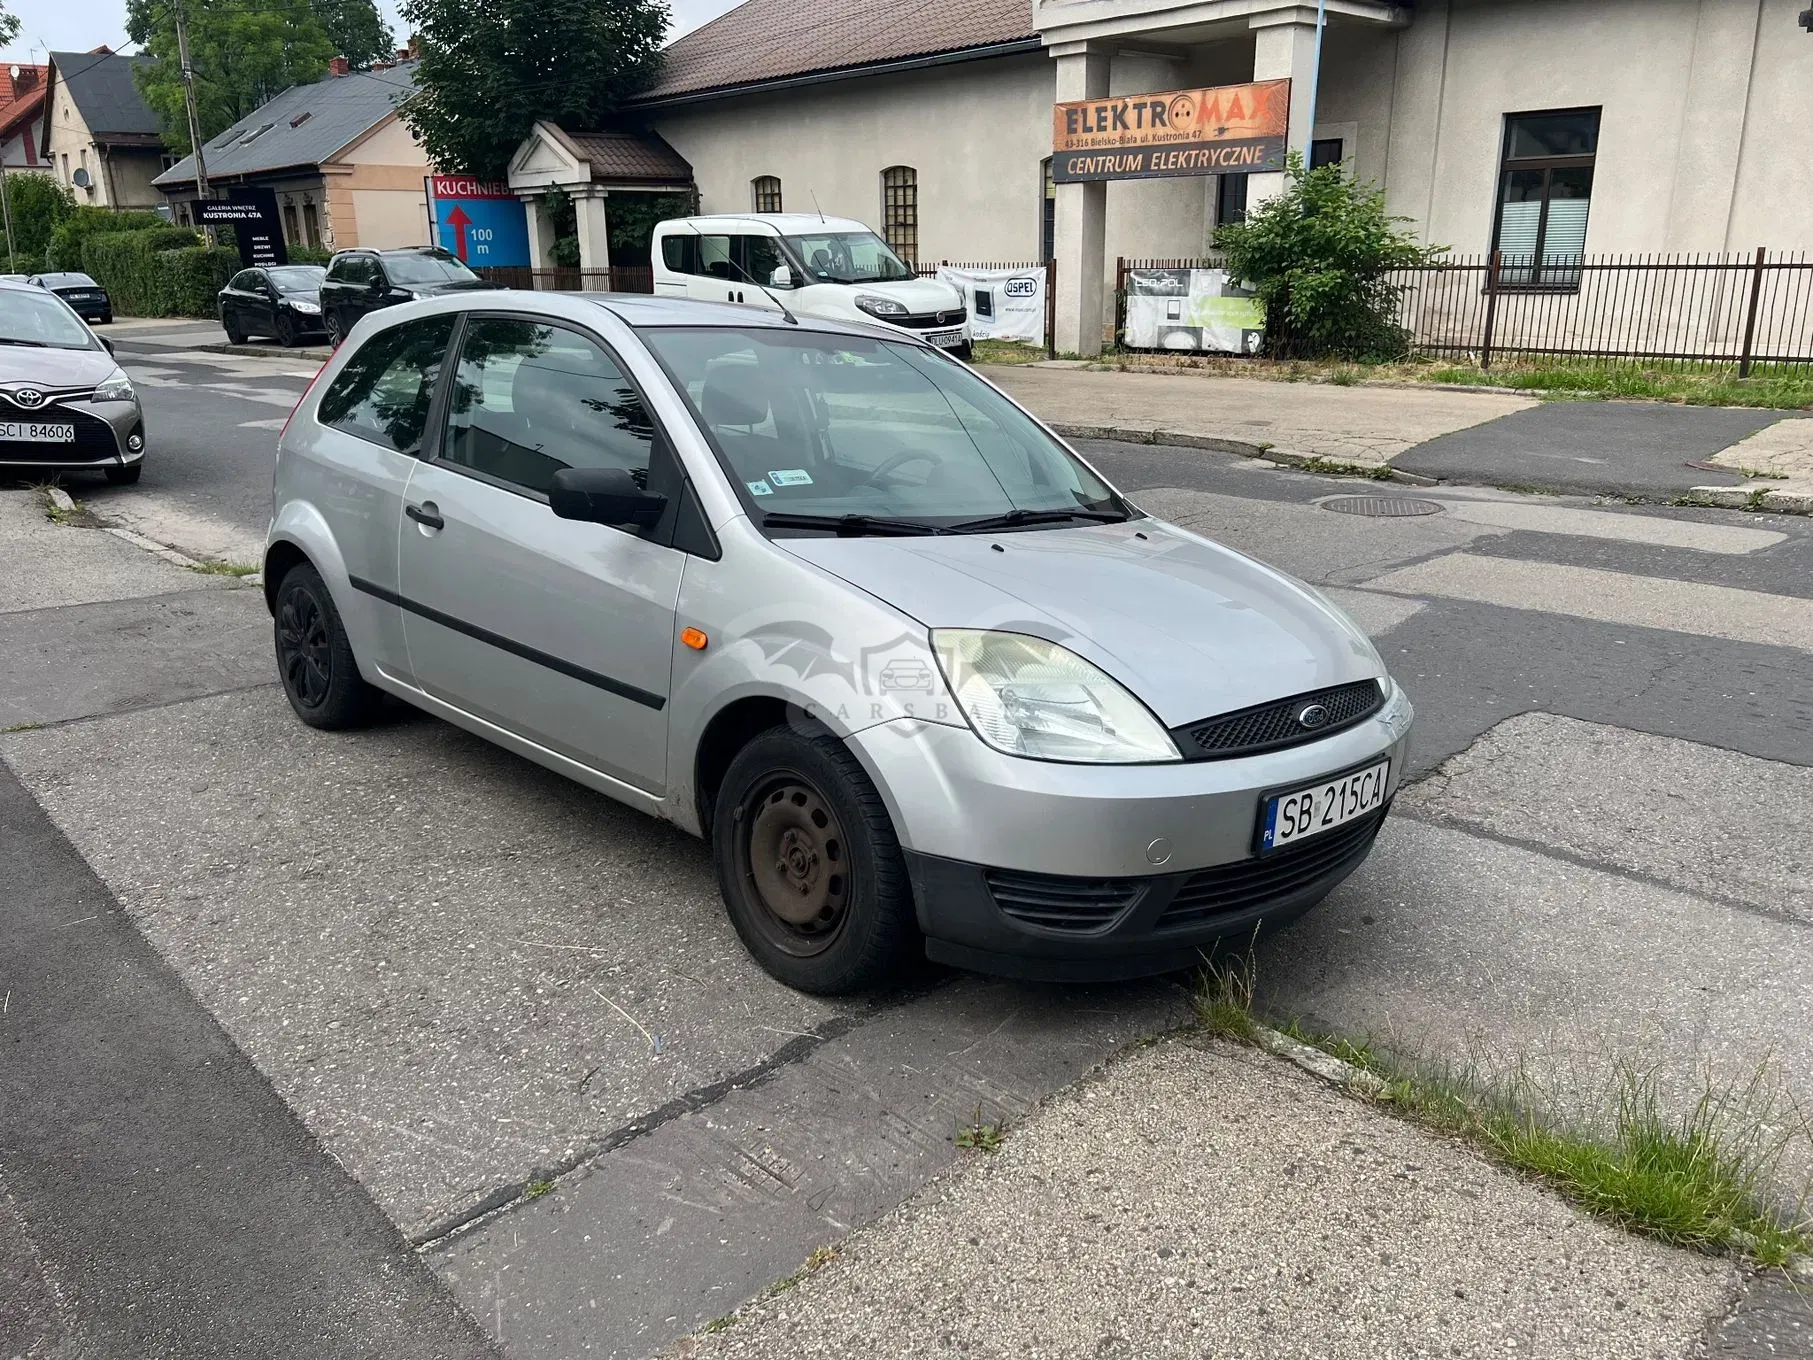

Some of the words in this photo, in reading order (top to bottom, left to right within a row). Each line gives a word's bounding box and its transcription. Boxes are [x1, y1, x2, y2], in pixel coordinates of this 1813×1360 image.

[1065, 138, 1089, 148] 43-316
[1140, 133, 1150, 143] ul.
[1152, 131, 1190, 143] Kustronia
[1191, 130, 1202, 139] 47
[1067, 153, 1143, 175] CENTRUM
[1150, 145, 1265, 171] ELEKTRYCZNE
[471, 228, 493, 241] 100
[477, 244, 489, 254] m
[1007, 282, 1033, 293] OSPEL
[0, 423, 22, 437] SCI
[29, 424, 73, 438] 84606
[1281, 792, 1313, 838] SB
[1321, 767, 1382, 826] 215CA
[1263, 829, 1273, 842] PL
